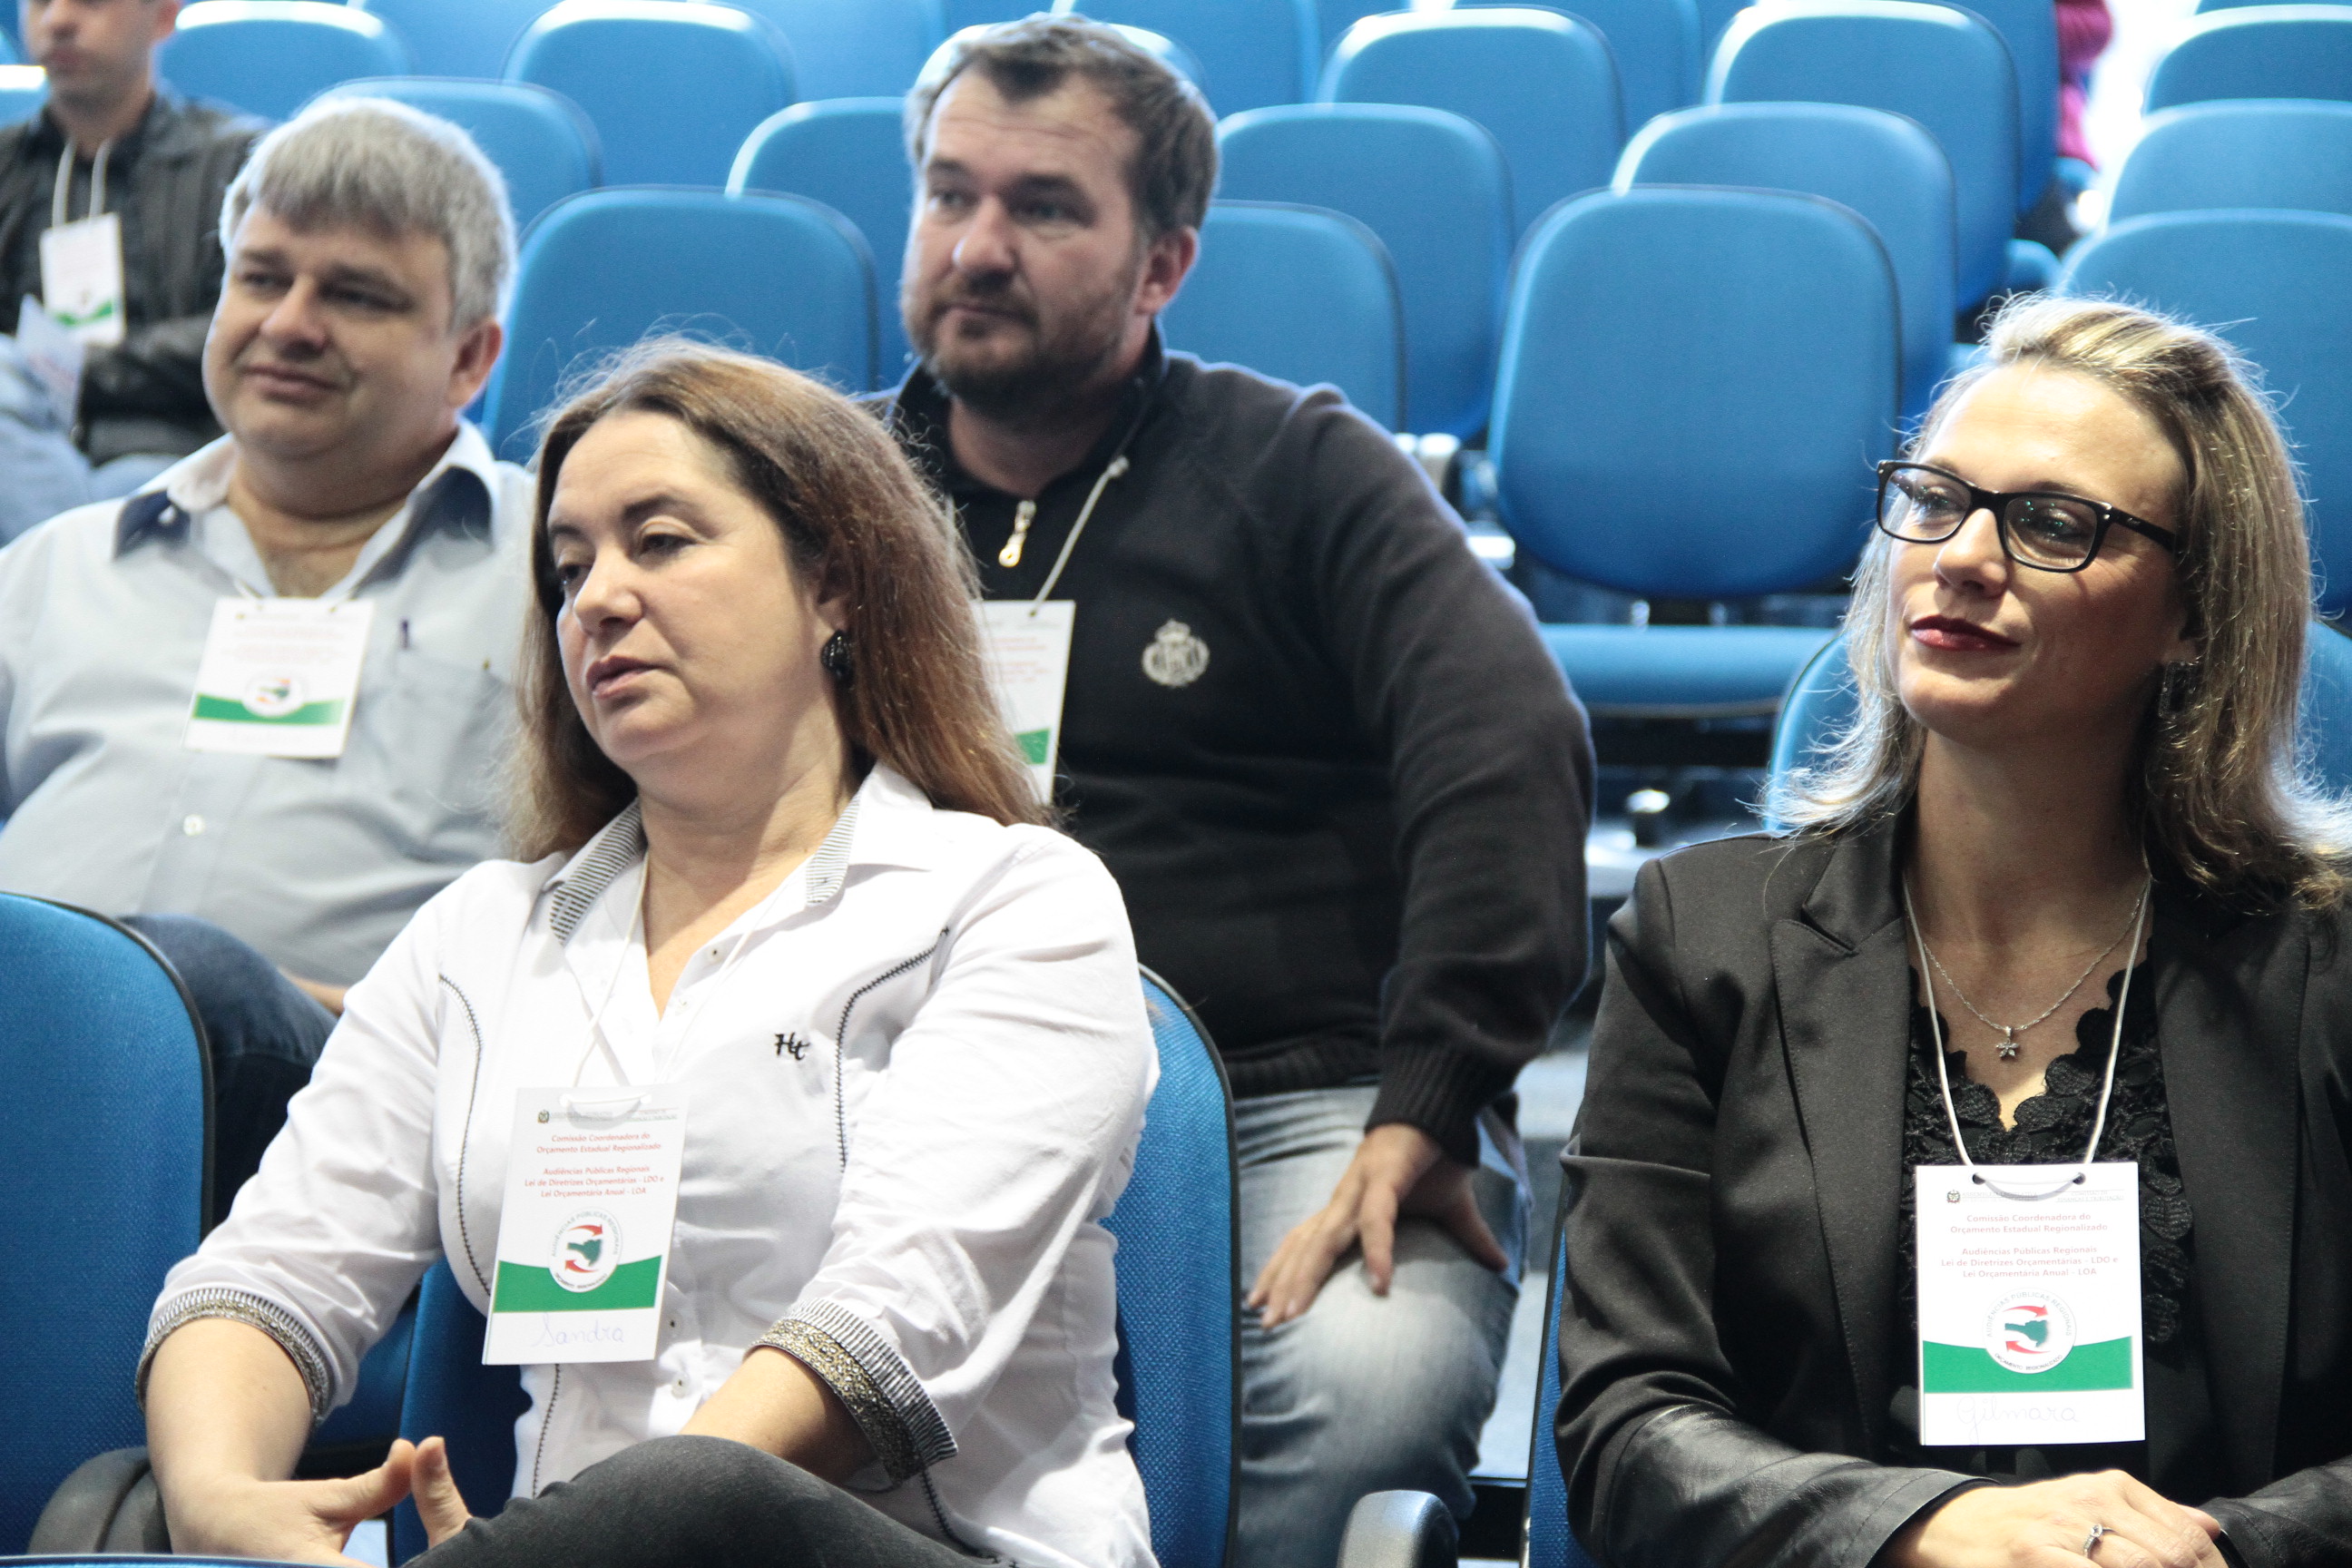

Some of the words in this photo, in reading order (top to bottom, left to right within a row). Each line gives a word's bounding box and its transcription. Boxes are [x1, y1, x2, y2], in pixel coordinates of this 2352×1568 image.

[552, 1134, 587, 1142] Comissão
[589, 1133, 639, 1142] Coordenadora
[641, 1132, 650, 1140] do
[536, 1145, 578, 1154] Orçamento
[580, 1144, 611, 1153] Estadual
[612, 1142, 662, 1153] Regionalizado
[544, 1167, 583, 1176] Audiências
[585, 1166, 614, 1175] Públicas
[616, 1165, 650, 1175] Regionais
[524, 1179, 535, 1187] Lei
[537, 1179, 546, 1187] de
[548, 1178, 583, 1187] Diretrizes
[585, 1176, 637, 1187] Orçamentárias
[643, 1175, 658, 1183] LDO
[541, 1190, 552, 1198] Lei
[554, 1189, 603, 1198] Orçamentária
[604, 1188, 625, 1196] Anual
[632, 1187, 647, 1195] LOA
[1966, 1214, 2010, 1222] Comissão
[2012, 1213, 2077, 1222] Coordenadora
[2079, 1212, 2092, 1220] do
[1950, 1225, 2001, 1235] Orçamento
[2003, 1224, 2041, 1233] Estadual
[2043, 1223, 2108, 1234] Regionalizado
[1961, 1248, 2011, 1256] Audiências
[2014, 1246, 2051, 1255] Públicas
[2053, 1246, 2098, 1255] Regionais
[1941, 1259, 1954, 1267] Lei
[1956, 1259, 1968, 1267] de
[1970, 1258, 2014, 1267] Diretrizes
[2016, 1257, 2082, 1268] Orçamentárias
[2091, 1256, 2111, 1264] LDO
[1963, 1269, 1975, 1278] Lei
[1978, 1269, 2040, 1279] Orçamentária
[2042, 1269, 2069, 1277] Anual
[2078, 1268, 2097, 1276] LOA
[2011, 1291, 2051, 1301] PÚBLICAS
[531, 1312, 624, 1347] Sandra
[1956, 1395, 2080, 1445] Gilmara
